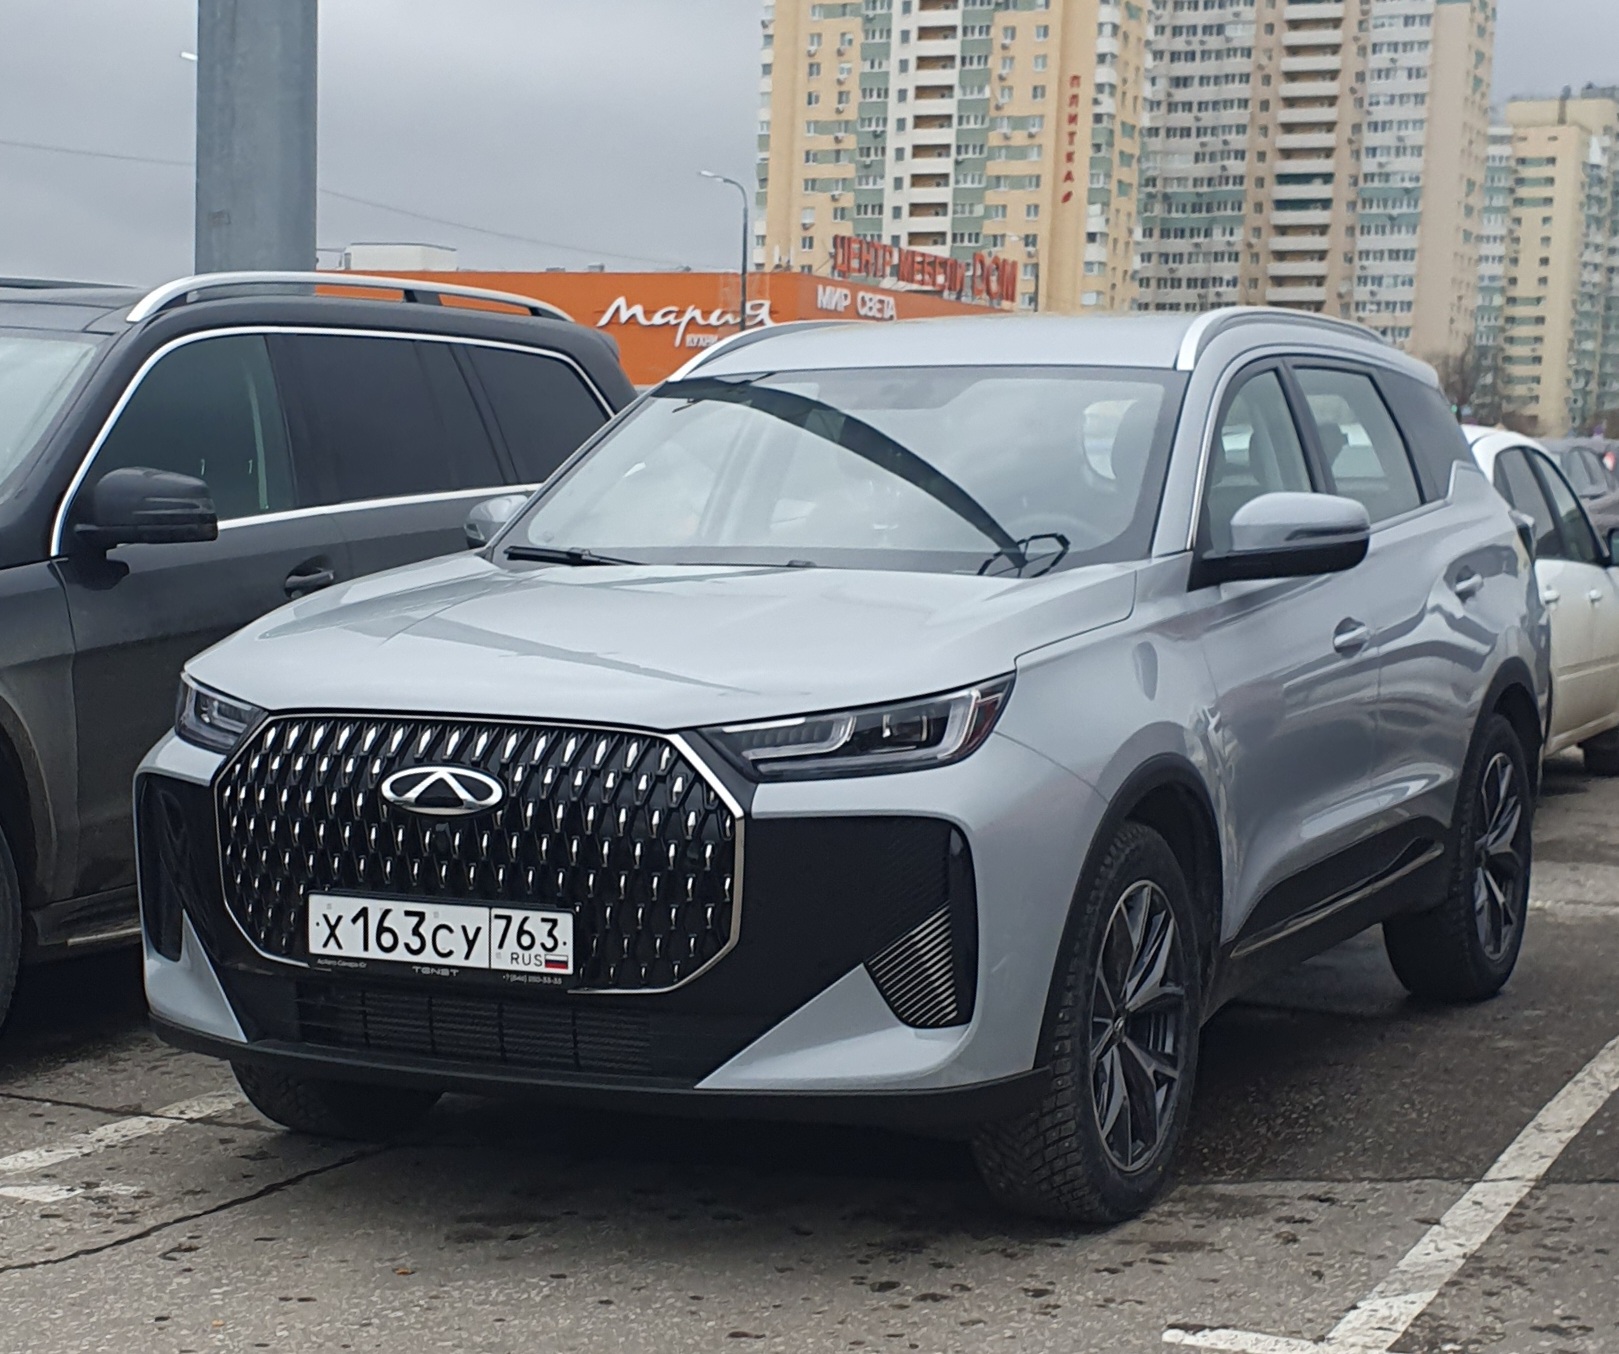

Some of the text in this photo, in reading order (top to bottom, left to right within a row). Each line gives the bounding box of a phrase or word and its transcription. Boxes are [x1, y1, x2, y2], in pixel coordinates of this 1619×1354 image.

[1063, 75, 1081, 183] ПЛИТКА
[833, 234, 893, 279] ЦЕНТР
[898, 247, 966, 292] МЕБЕЛИ
[596, 296, 776, 348] Мария
[817, 284, 897, 321] МИР СВЕТА
[494, 913, 559, 951] 763
[510, 951, 543, 968] RUS
